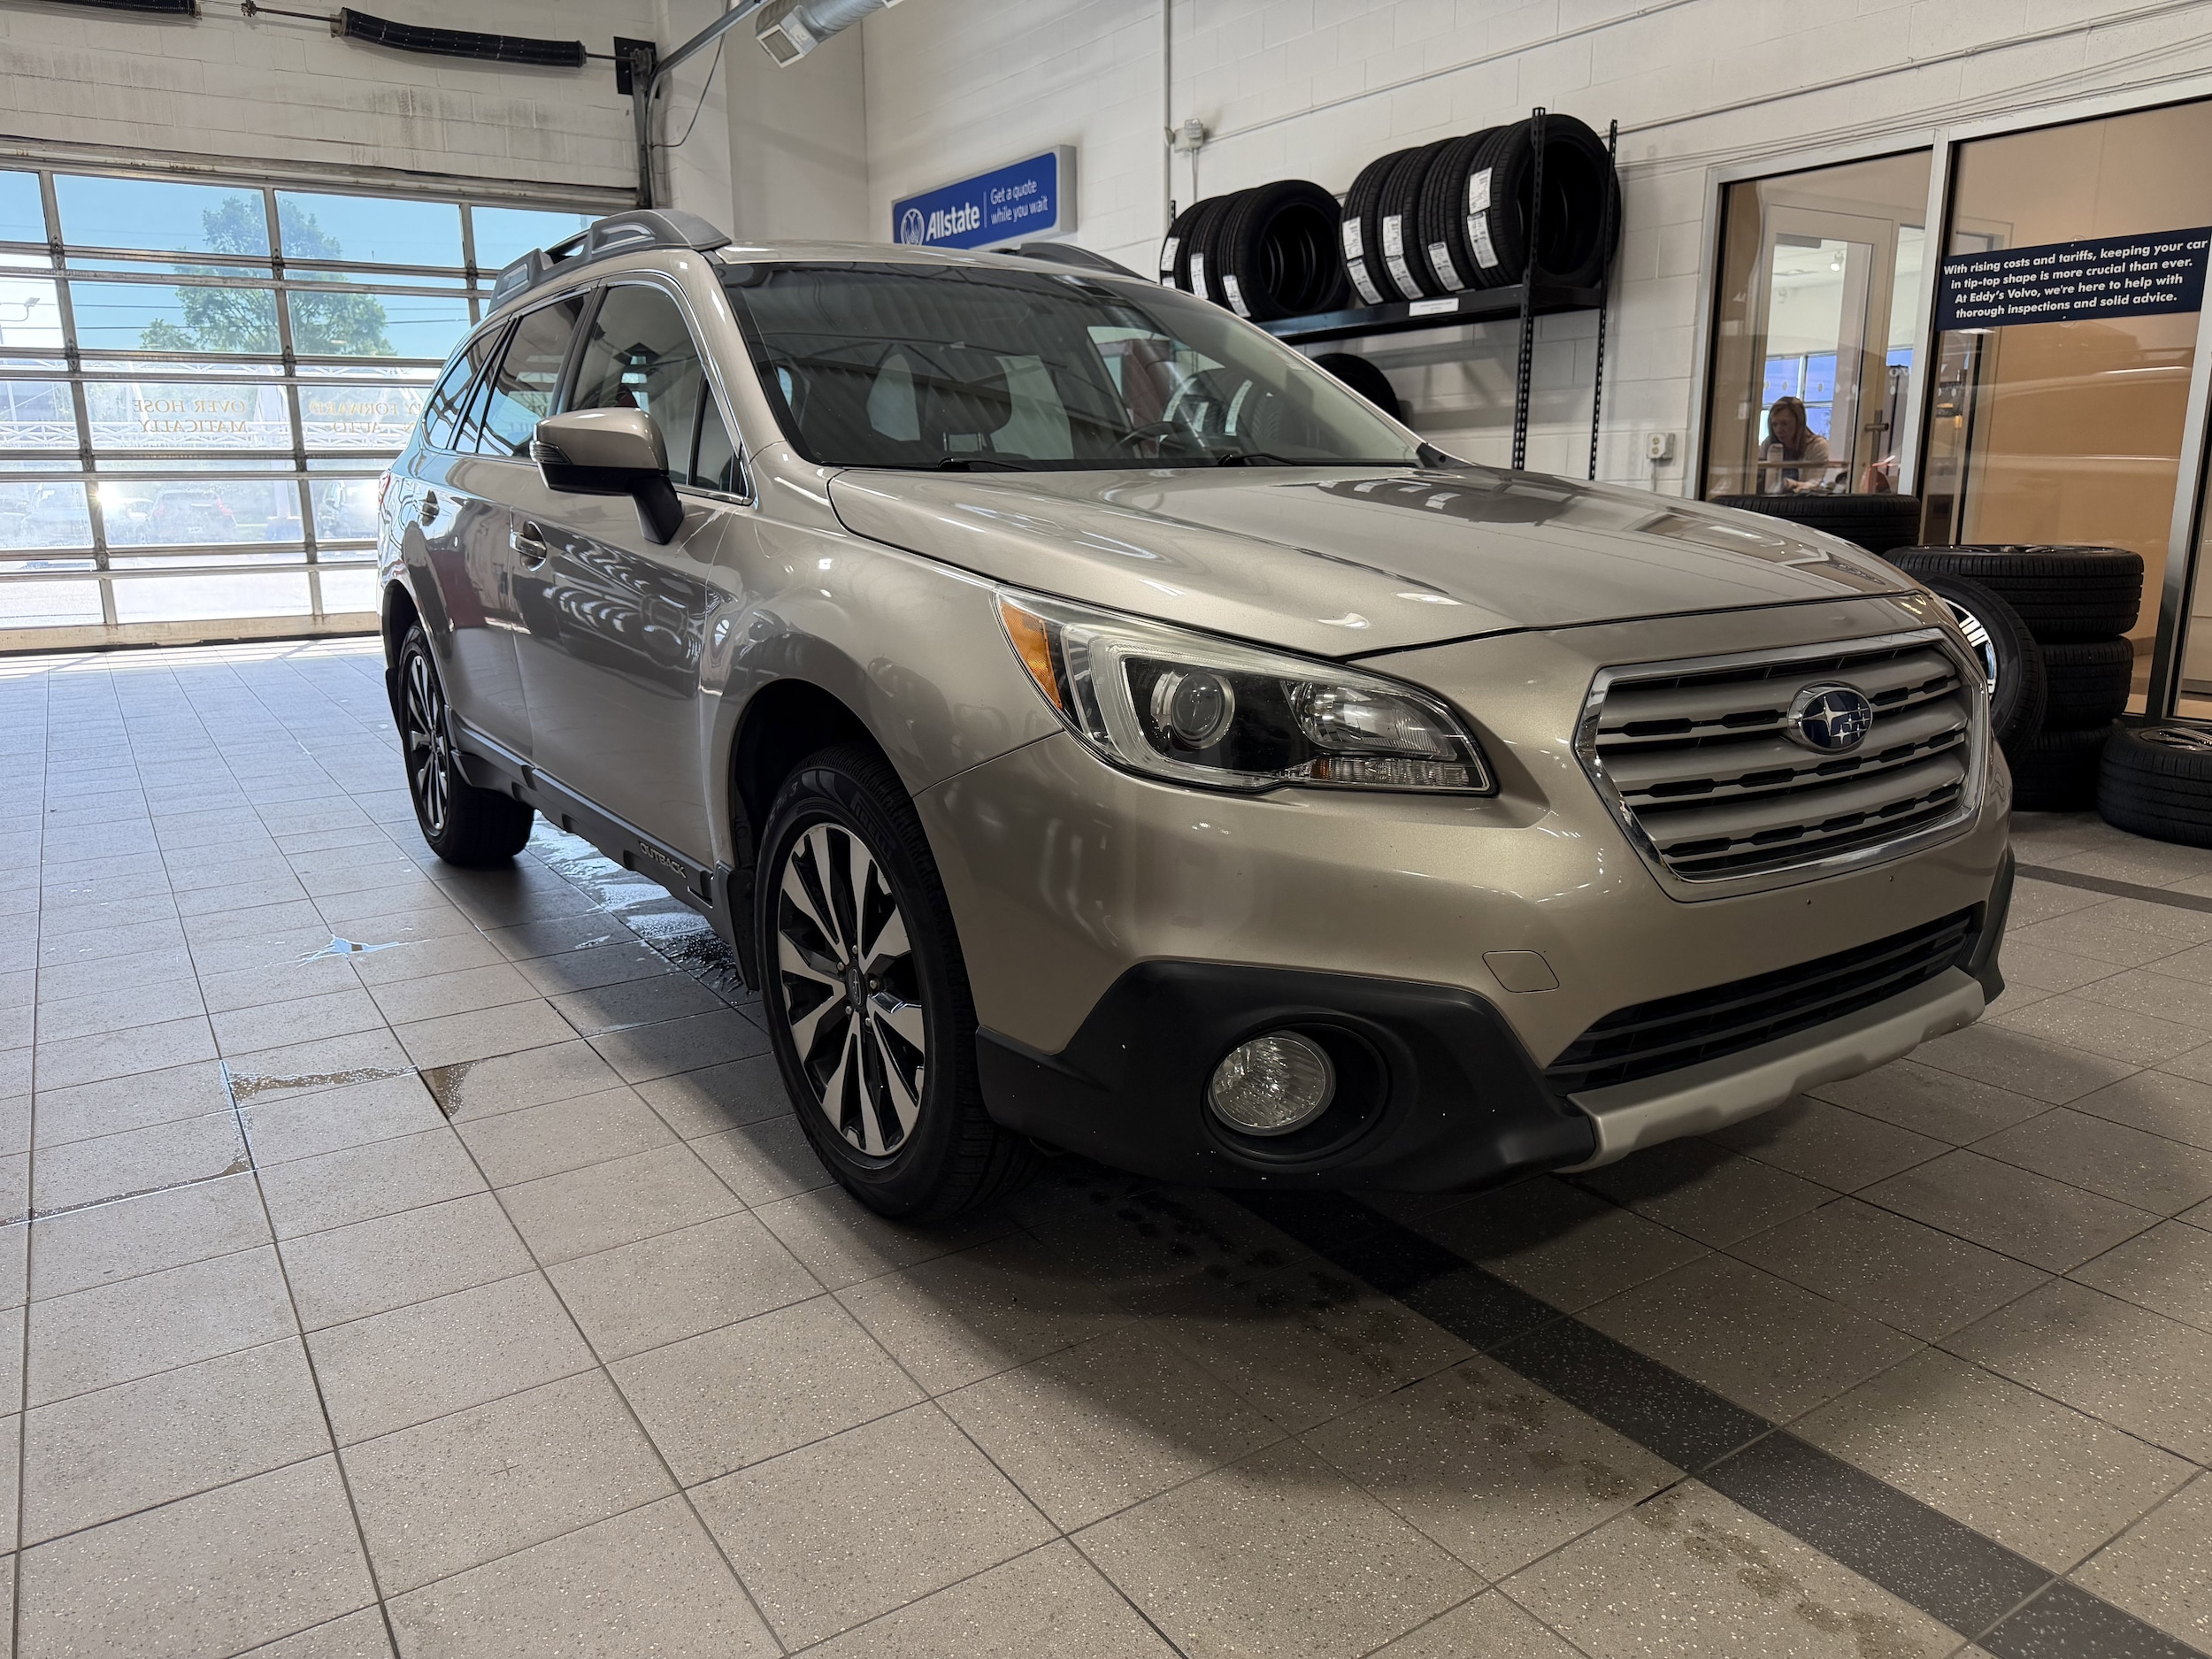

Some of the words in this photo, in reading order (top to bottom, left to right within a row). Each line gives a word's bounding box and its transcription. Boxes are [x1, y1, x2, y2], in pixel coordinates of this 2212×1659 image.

[990, 187, 1006, 204] Get
[1006, 188, 1012, 201] a
[1013, 179, 1037, 201] quote
[926, 202, 980, 242] Allstate
[991, 206, 1012, 225] while
[1013, 204, 1028, 223] you
[1029, 196, 1048, 214] wait
[1944, 264, 1967, 275] With
[1970, 261, 2001, 272] rising
[2003, 258, 2030, 269] costs
[2033, 253, 2055, 265] and
[2059, 250, 2097, 264] tariffs,
[2101, 245, 2150, 258] keeping
[2154, 242, 2184, 256] your
[2186, 239, 2208, 250] car
[1951, 280, 1962, 289] in
[1964, 277, 2001, 289] tip-top
[2002, 273, 2037, 285] shape
[2039, 271, 2049, 280] is
[2053, 268, 2083, 280] more
[2085, 262, 2125, 276] crucial
[2129, 261, 2158, 272] than
[2162, 258, 2193, 269] ever.
[1955, 294, 1967, 303] At
[2008, 288, 2041, 299] Volvo,
[2044, 285, 2075, 296] we're
[2078, 282, 2106, 293] here
[2109, 280, 2121, 289] to
[2124, 277, 2153, 289] help
[2155, 273, 2183, 286] with
[1955, 305, 2005, 319] thorough
[2008, 301, 2070, 315] inspections
[2073, 296, 2097, 309] and
[2100, 294, 2130, 307] solid
[2132, 292, 2177, 304] advice.
[640, 842, 687, 879] OUTBACK
